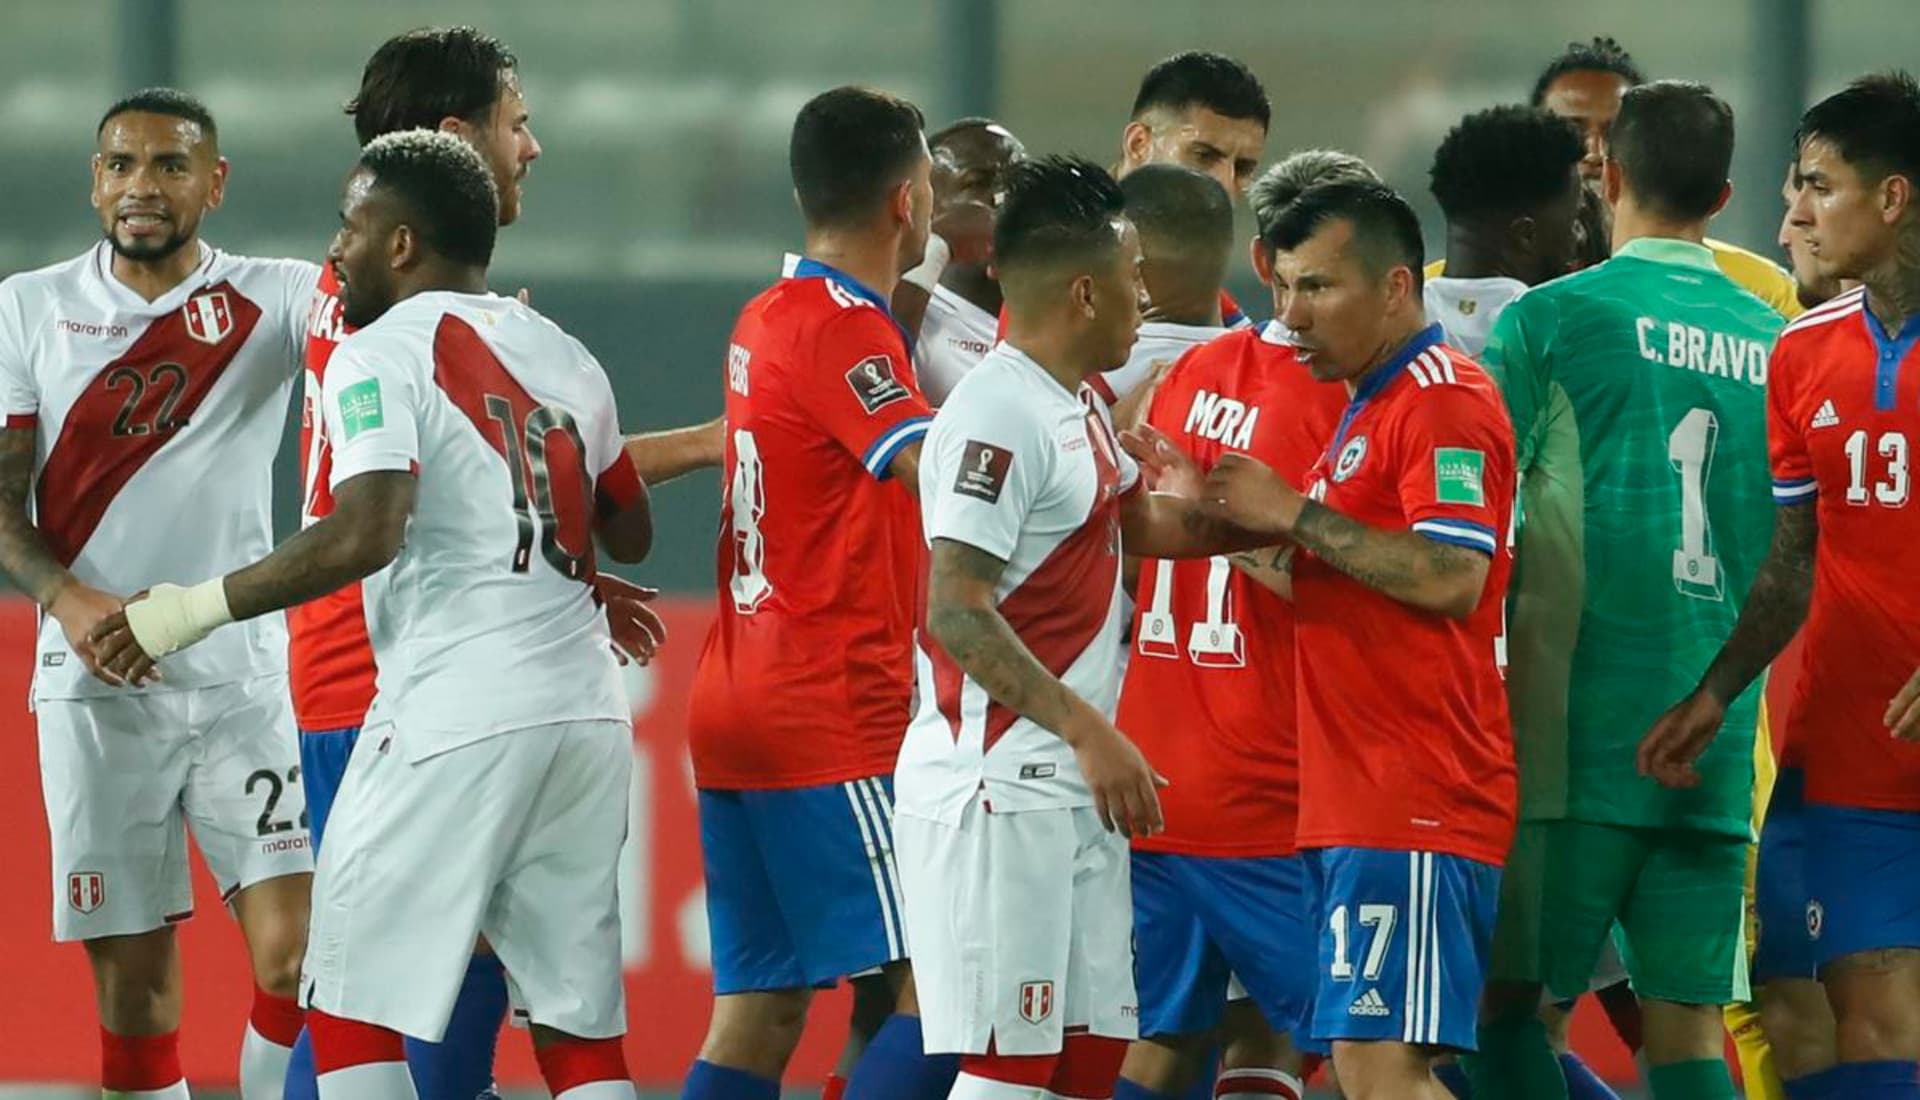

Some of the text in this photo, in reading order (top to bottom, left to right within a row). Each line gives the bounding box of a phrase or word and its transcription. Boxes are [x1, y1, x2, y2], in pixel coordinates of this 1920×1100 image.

[57, 319, 128, 337] marathon
[105, 361, 190, 437] 22
[1184, 389, 1259, 450] MORA
[484, 394, 594, 580] 10
[1668, 408, 1725, 602] 1
[1845, 429, 1911, 508] 13
[1330, 904, 1398, 982] 17
[1348, 1005, 1391, 1017] adidas
